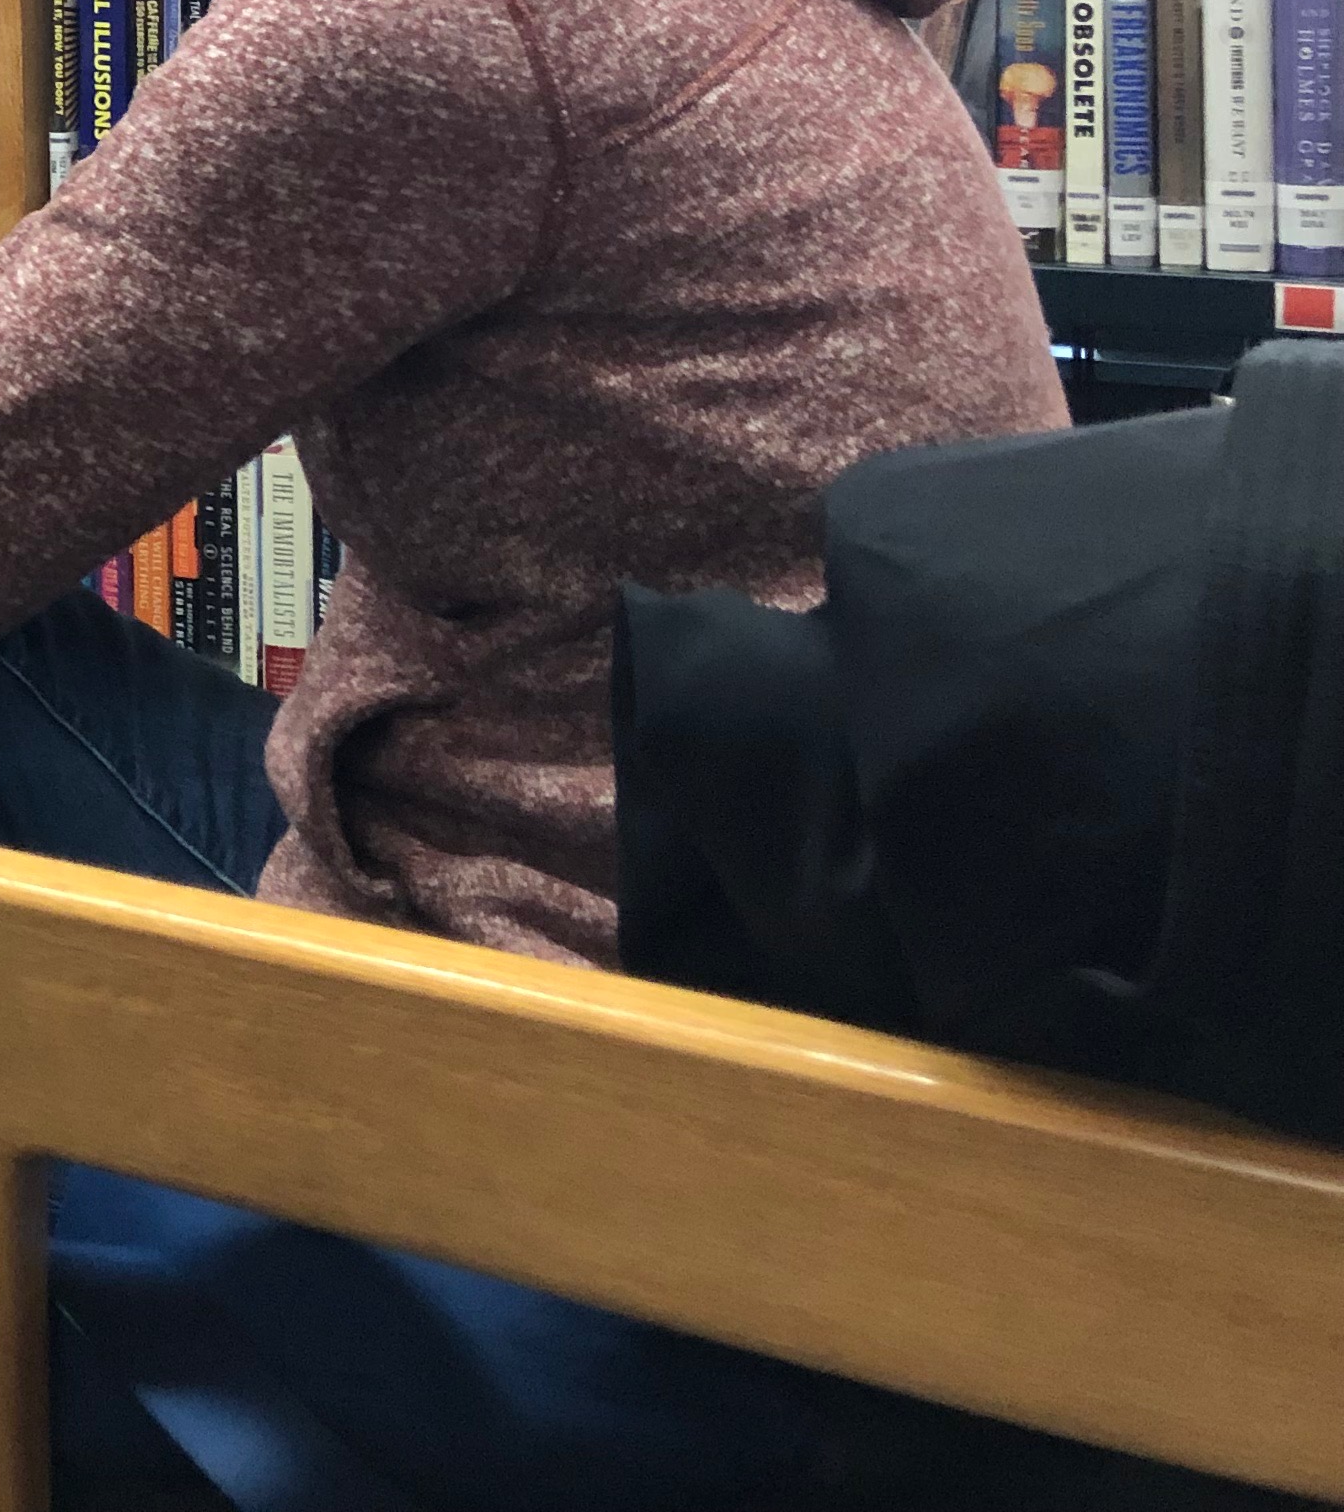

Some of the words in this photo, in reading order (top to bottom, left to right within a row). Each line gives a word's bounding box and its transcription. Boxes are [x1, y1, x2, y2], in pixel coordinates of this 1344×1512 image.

[1014, 21, 1046, 52] Soon
[54, 57, 64, 79] YOU
[93, 21, 112, 141] ILLUSIONS
[1072, 2, 1095, 139] OBSOLETE
[1296, 28, 1316, 122] HOLMES
[1110, 5, 1152, 176] FREAKONOMICS
[1231, 96, 1245, 118] WE
[1231, 120, 1246, 159] WANT
[271, 473, 294, 504] THE
[221, 508, 233, 538] REAL
[152, 541, 163, 572] WILL
[220, 546, 233, 599] SCIENCE
[272, 512, 296, 639] IMMORTALISTS
[222, 607, 233, 654] BEHIND
